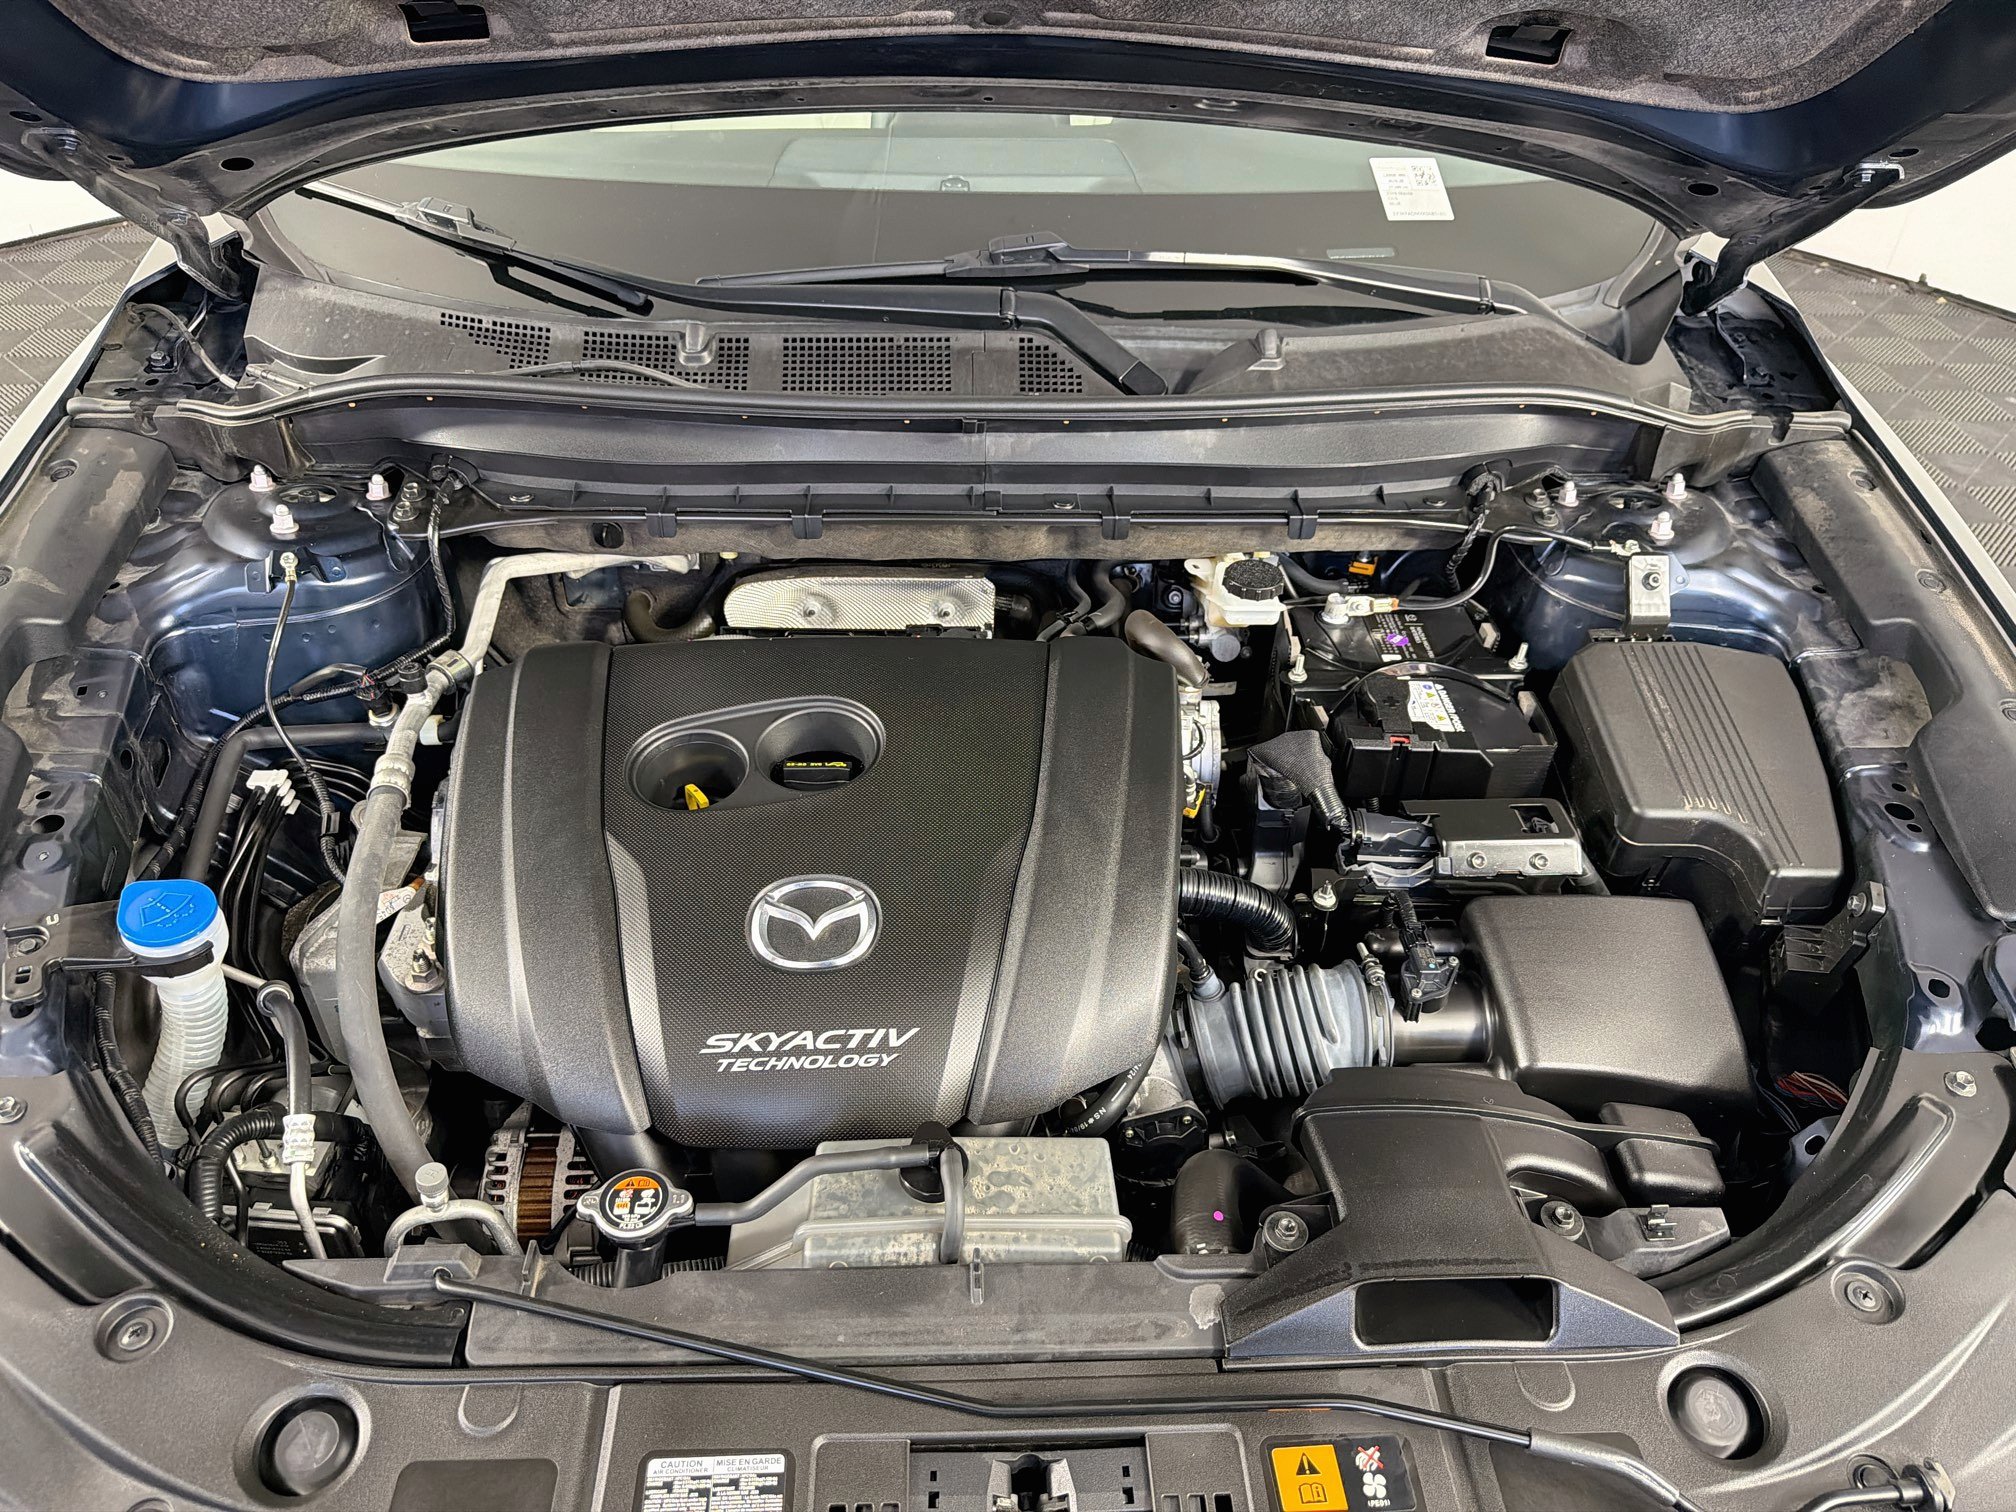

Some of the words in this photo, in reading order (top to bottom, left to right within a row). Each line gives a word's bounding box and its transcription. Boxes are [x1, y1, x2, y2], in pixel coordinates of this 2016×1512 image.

[698, 1028, 921, 1055] SKYACTIV
[717, 1053, 901, 1073] TECHNOLOGY
[660, 1459, 703, 1469] CAUTION
[716, 1458, 737, 1466] MISE
[738, 1458, 751, 1466] EN
[751, 1457, 782, 1465] GARDE
[665, 1467, 709, 1475] CONDITIONER
